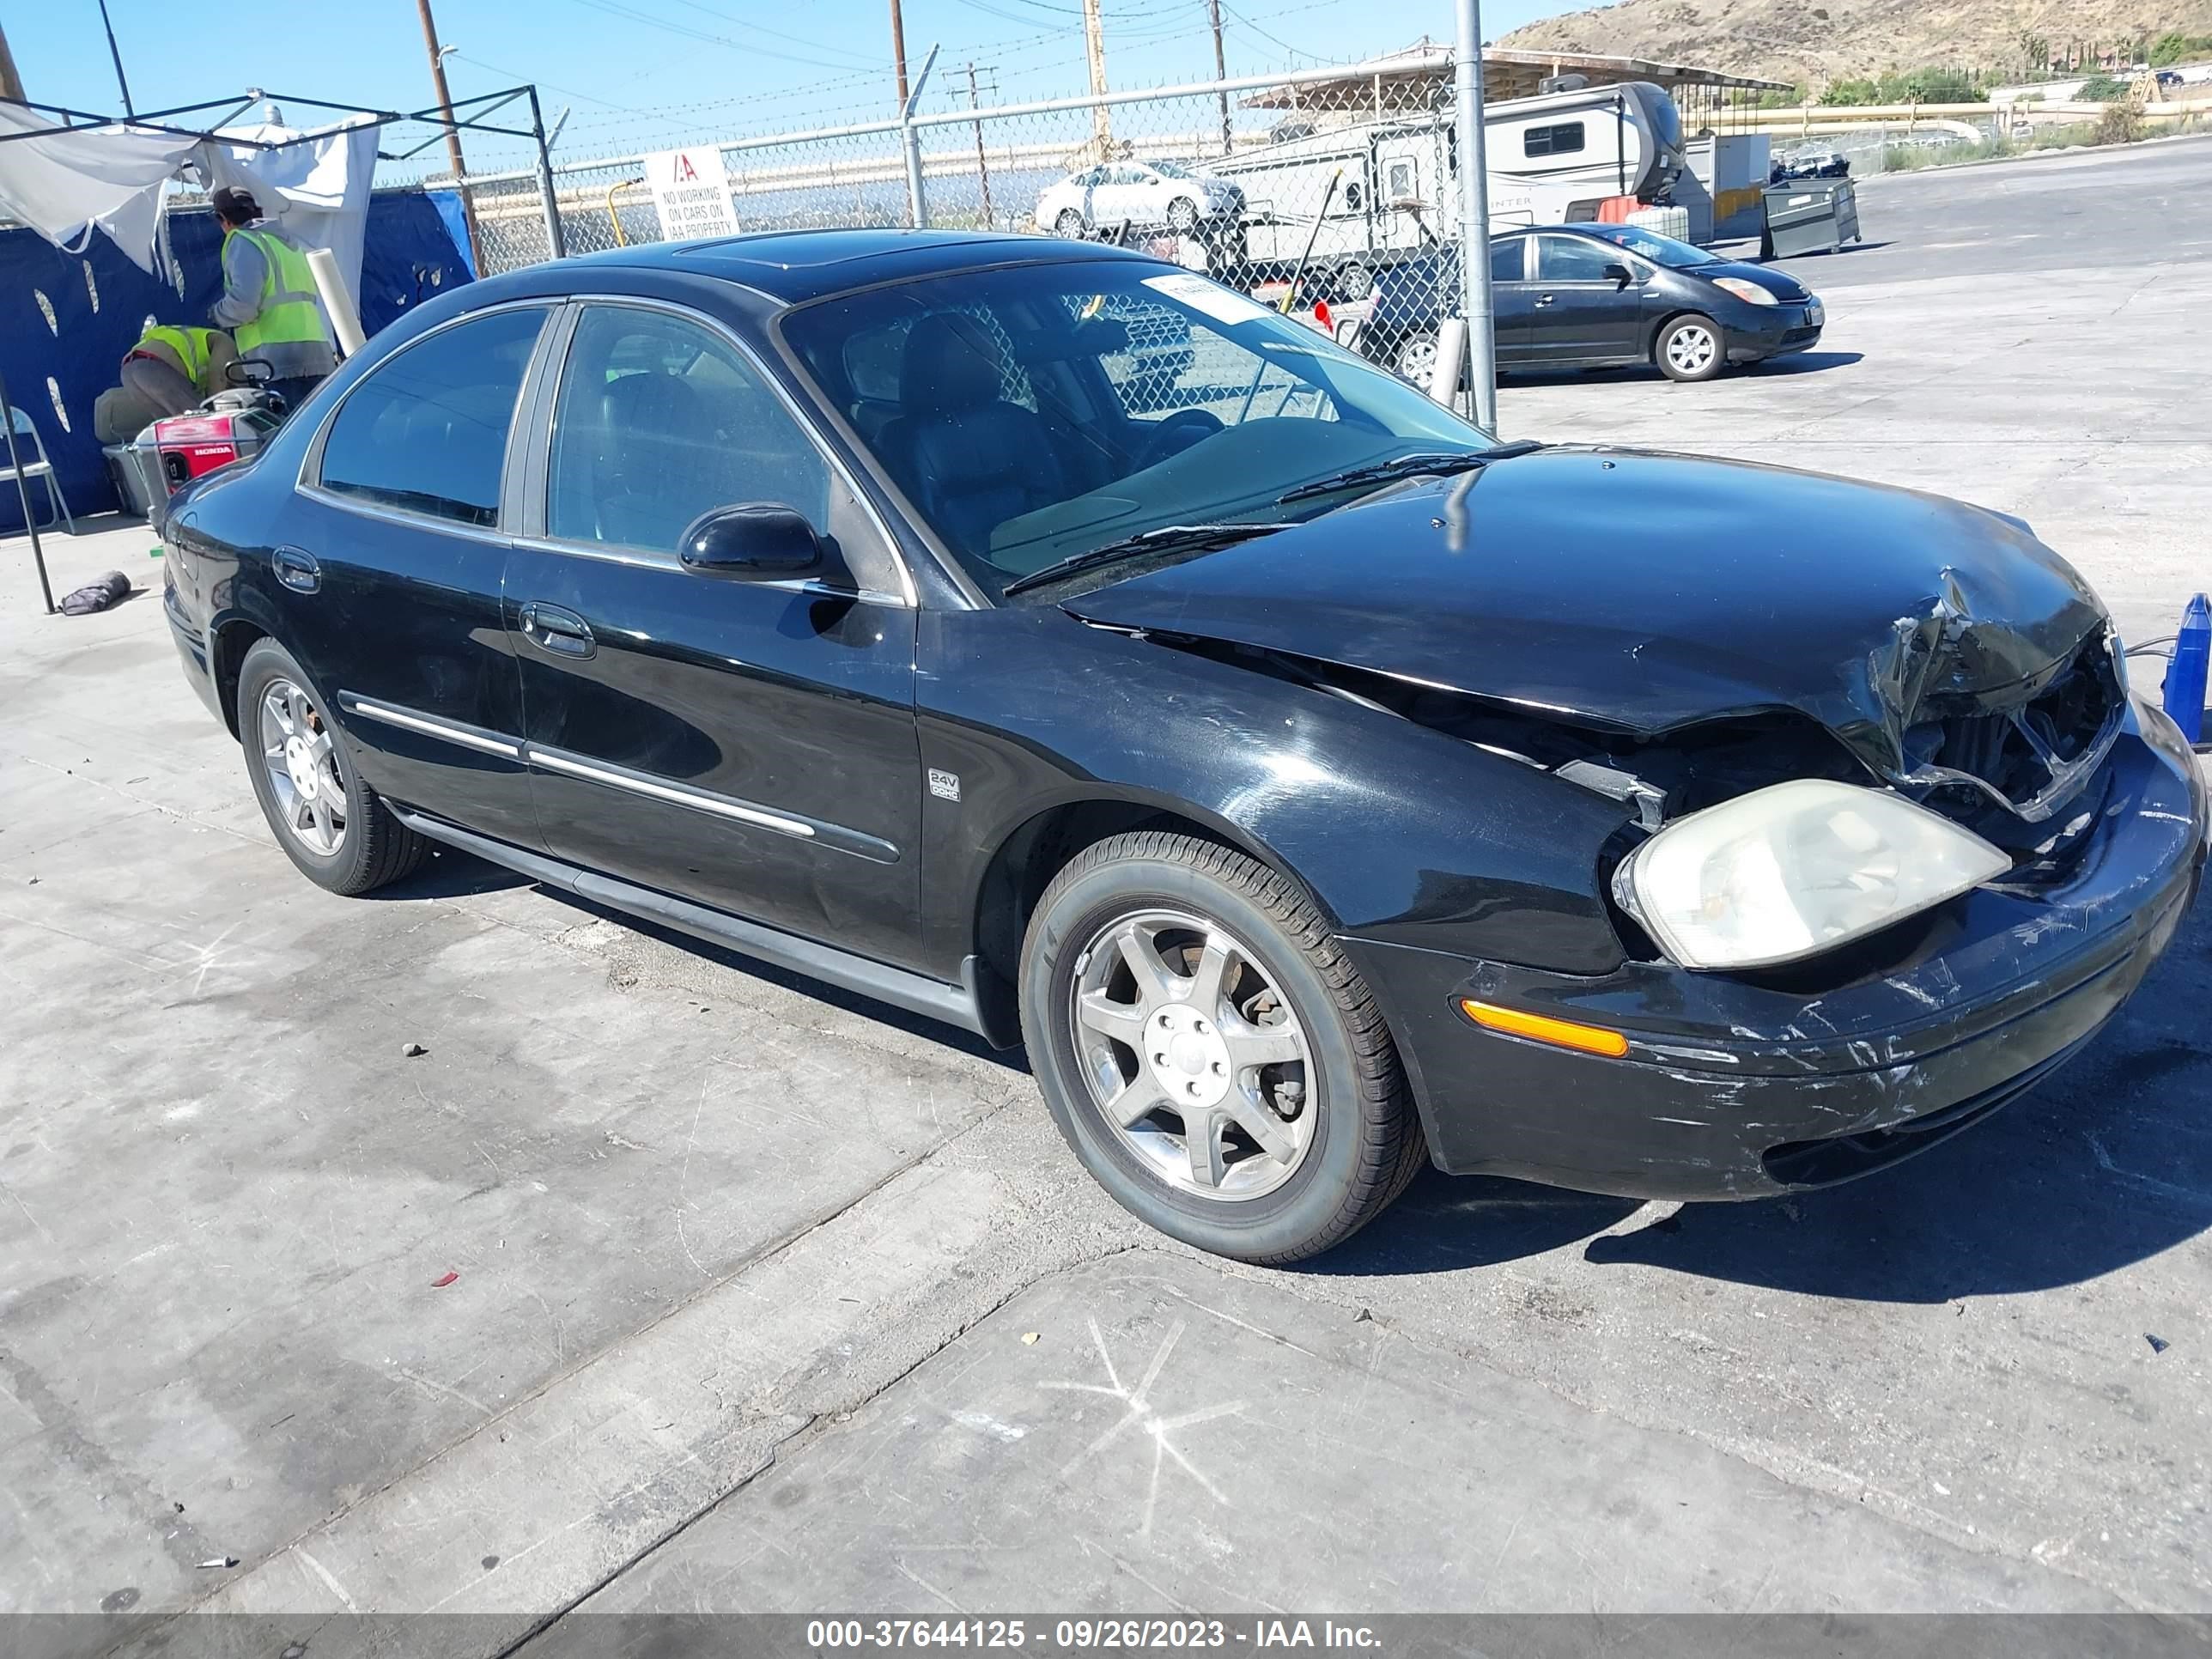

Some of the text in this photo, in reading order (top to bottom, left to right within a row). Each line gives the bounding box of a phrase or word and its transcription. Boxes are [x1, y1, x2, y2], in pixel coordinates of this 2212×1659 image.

[663, 186, 721, 204] NO WORKING
[668, 204, 724, 222] ON CARS ON
[668, 222, 732, 240] IAA PROPERTY
[195, 447, 232, 455] HONDA
[931, 773, 957, 787] 24V
